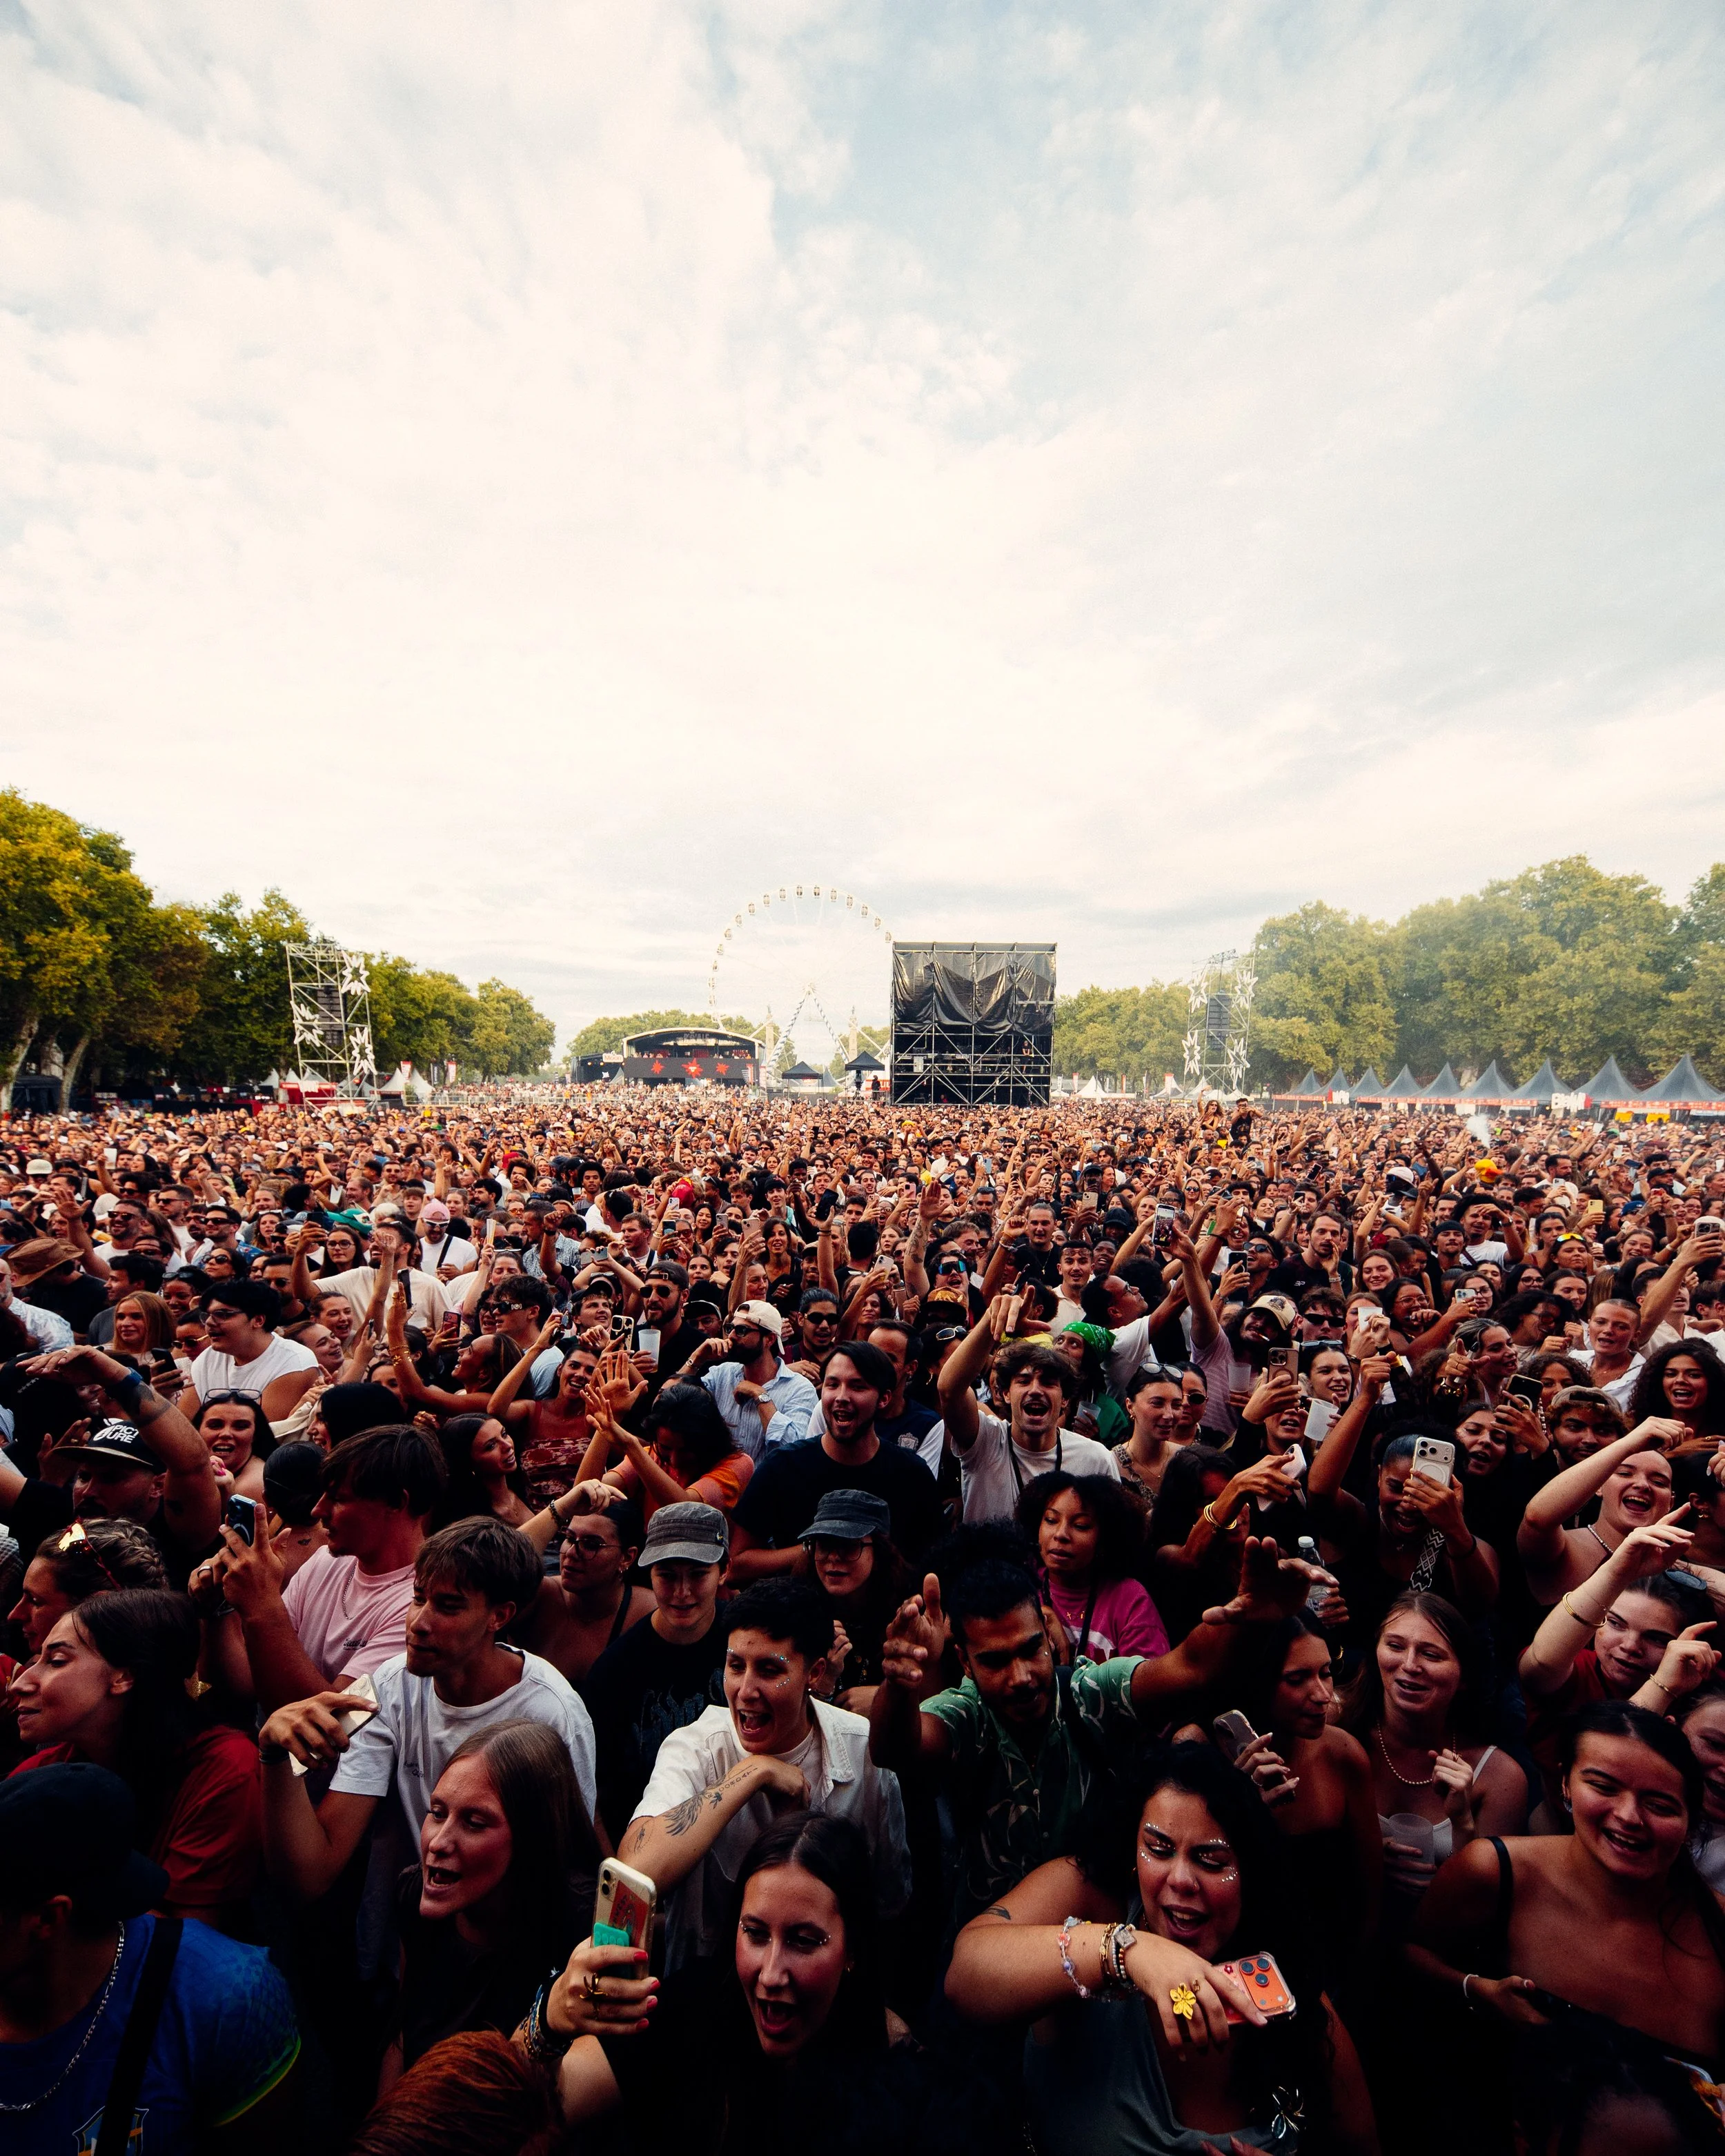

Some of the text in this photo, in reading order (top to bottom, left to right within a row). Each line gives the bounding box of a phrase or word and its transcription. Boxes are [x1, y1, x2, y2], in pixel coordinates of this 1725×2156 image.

[112, 1425, 139, 1436] PICT
[106, 1431, 135, 1443] URE
[707, 1767, 758, 1799] RCORDATI
